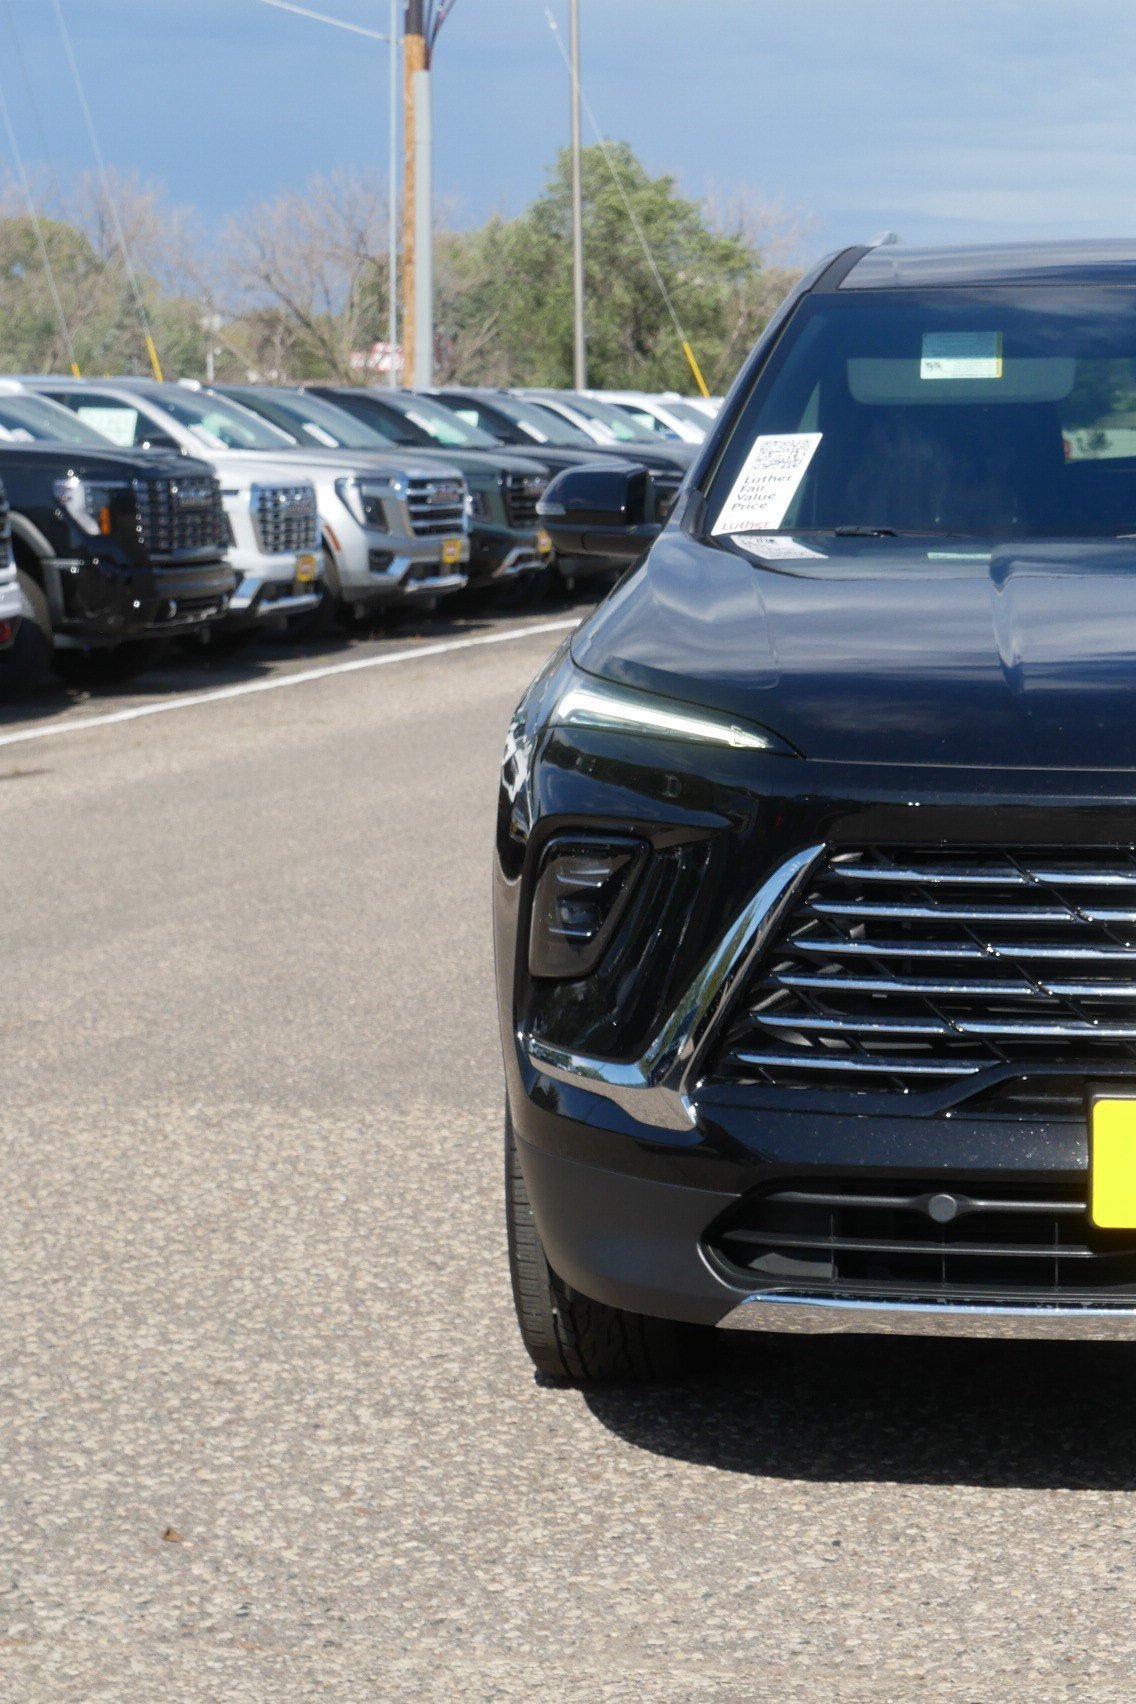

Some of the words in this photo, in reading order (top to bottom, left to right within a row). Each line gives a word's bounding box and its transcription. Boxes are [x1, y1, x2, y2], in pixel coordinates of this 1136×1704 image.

[744, 475, 792, 484] Luther
[740, 485, 765, 493] Fair
[737, 493, 776, 501] Value
